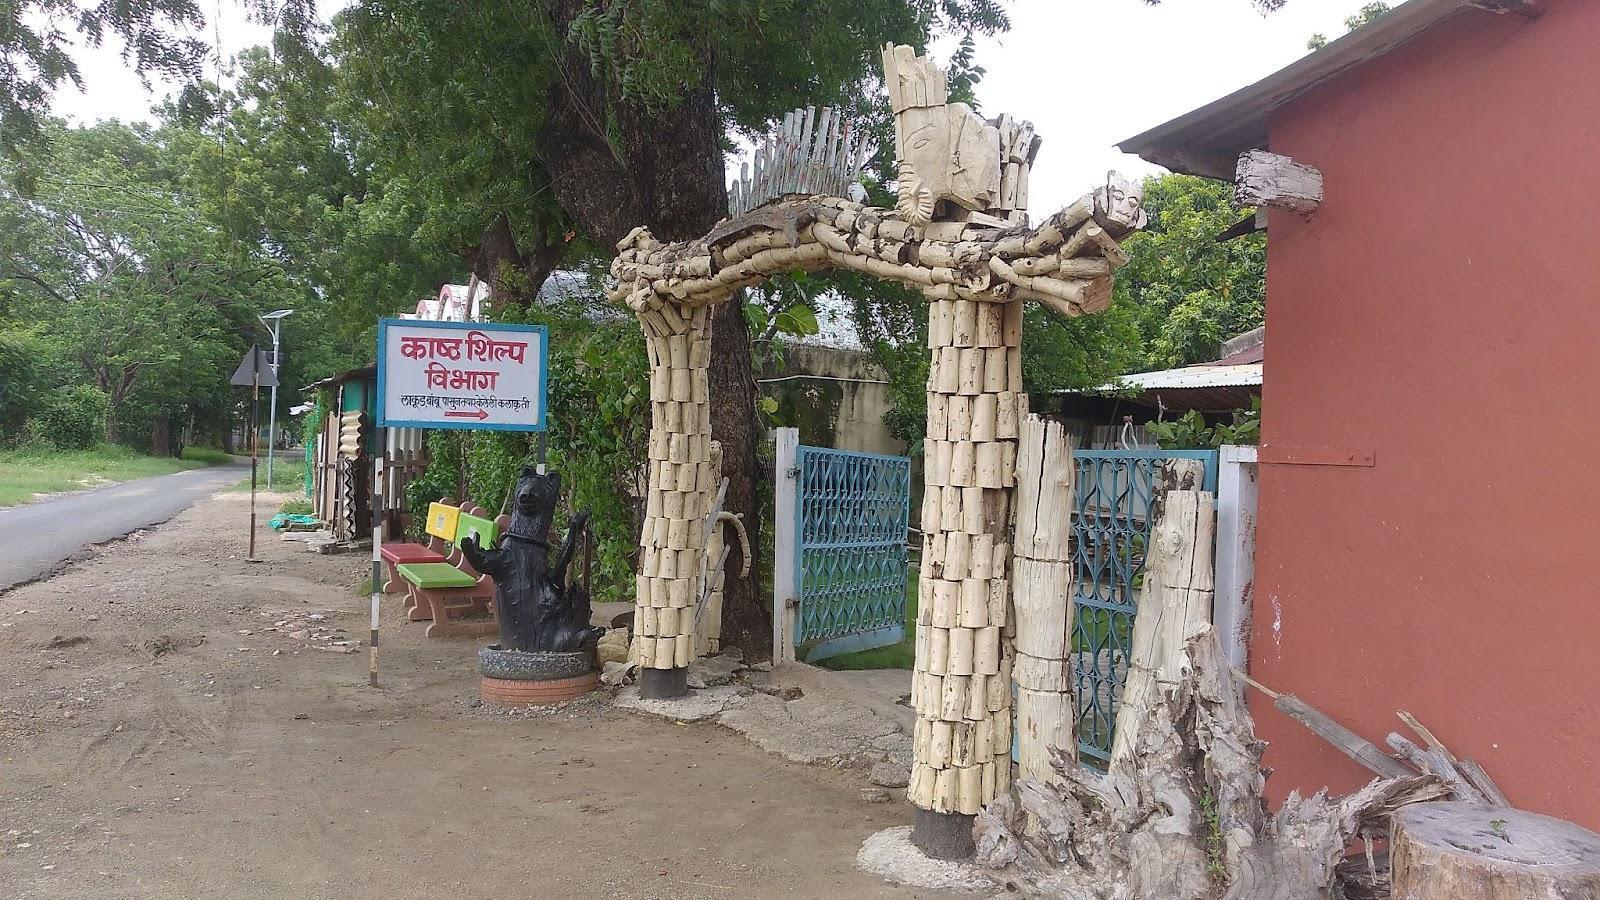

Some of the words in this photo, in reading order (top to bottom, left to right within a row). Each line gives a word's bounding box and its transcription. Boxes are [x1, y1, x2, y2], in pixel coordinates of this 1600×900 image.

[401, 336, 463, 361] काष्ठ
[465, 330, 528, 364] शिल्प
[424, 361, 499, 391] विभाग
